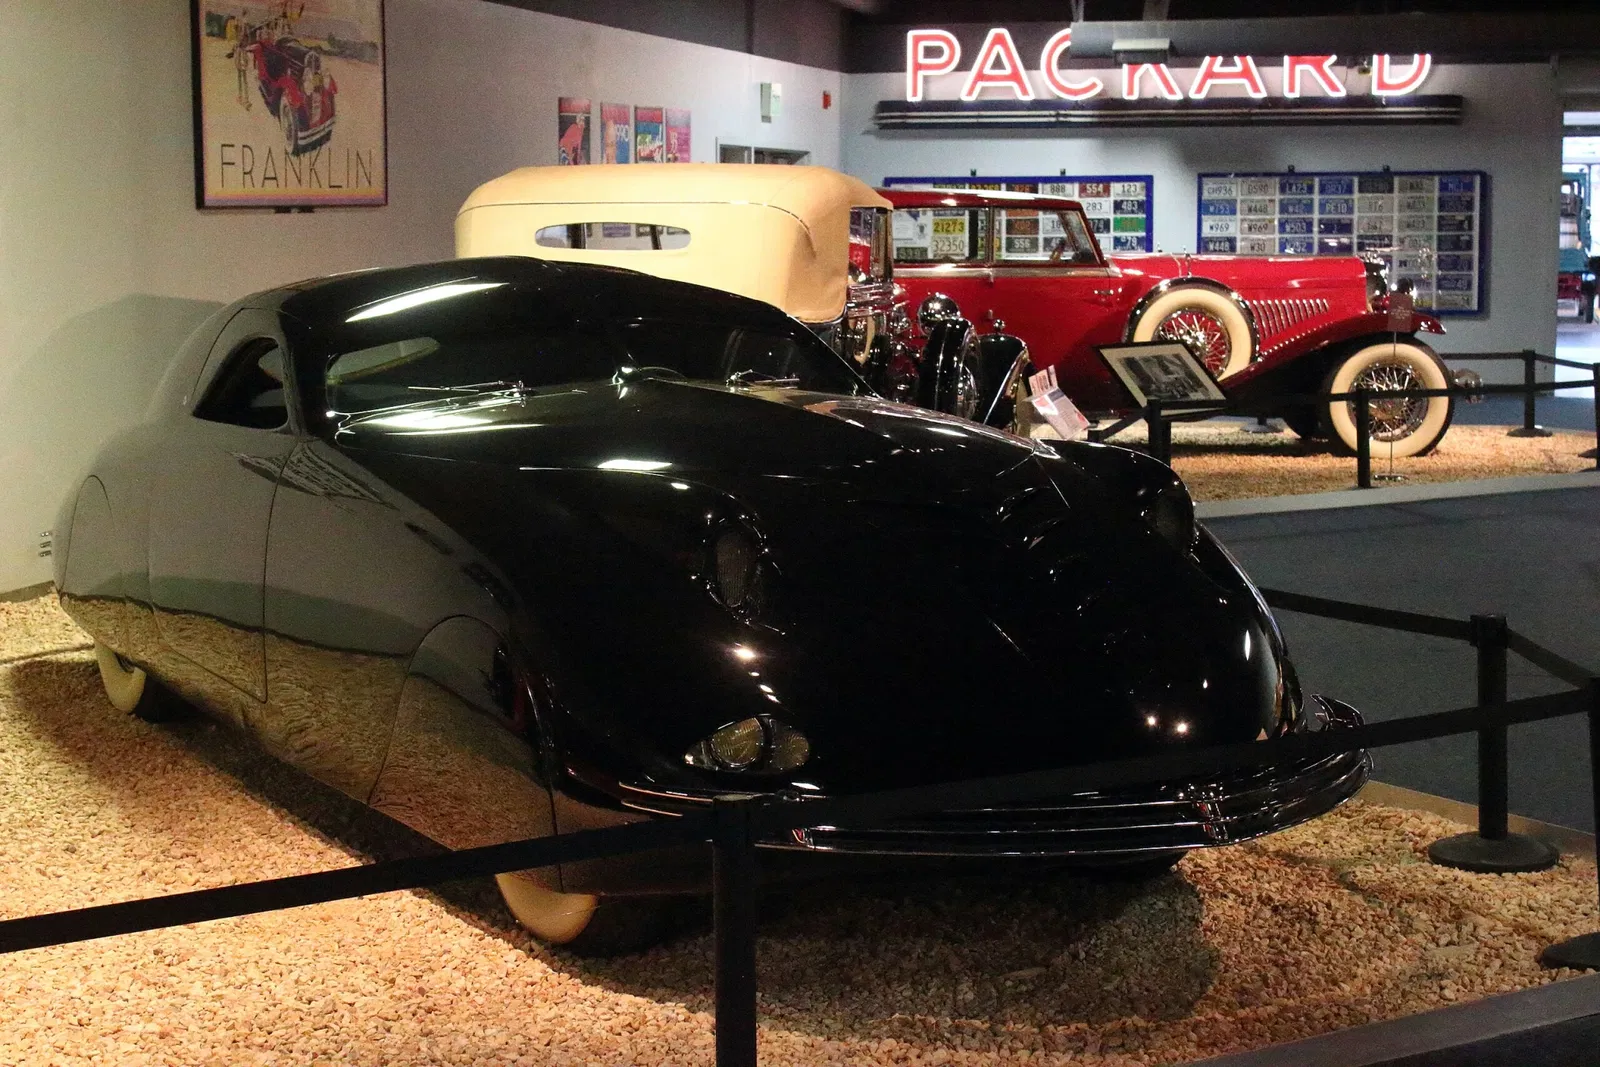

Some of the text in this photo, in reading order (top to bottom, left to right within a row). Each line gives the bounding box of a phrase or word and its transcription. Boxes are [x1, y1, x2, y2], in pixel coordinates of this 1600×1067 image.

[220, 144, 373, 189] FRANKLIN
[1086, 183, 1104, 194] 554
[1122, 184, 1138, 194] 123
[1086, 202, 1103, 211] 283
[933, 221, 965, 233] 21273
[1209, 223, 1230, 231] W969
[1247, 223, 1268, 232] W969
[933, 240, 964, 252] 32350
